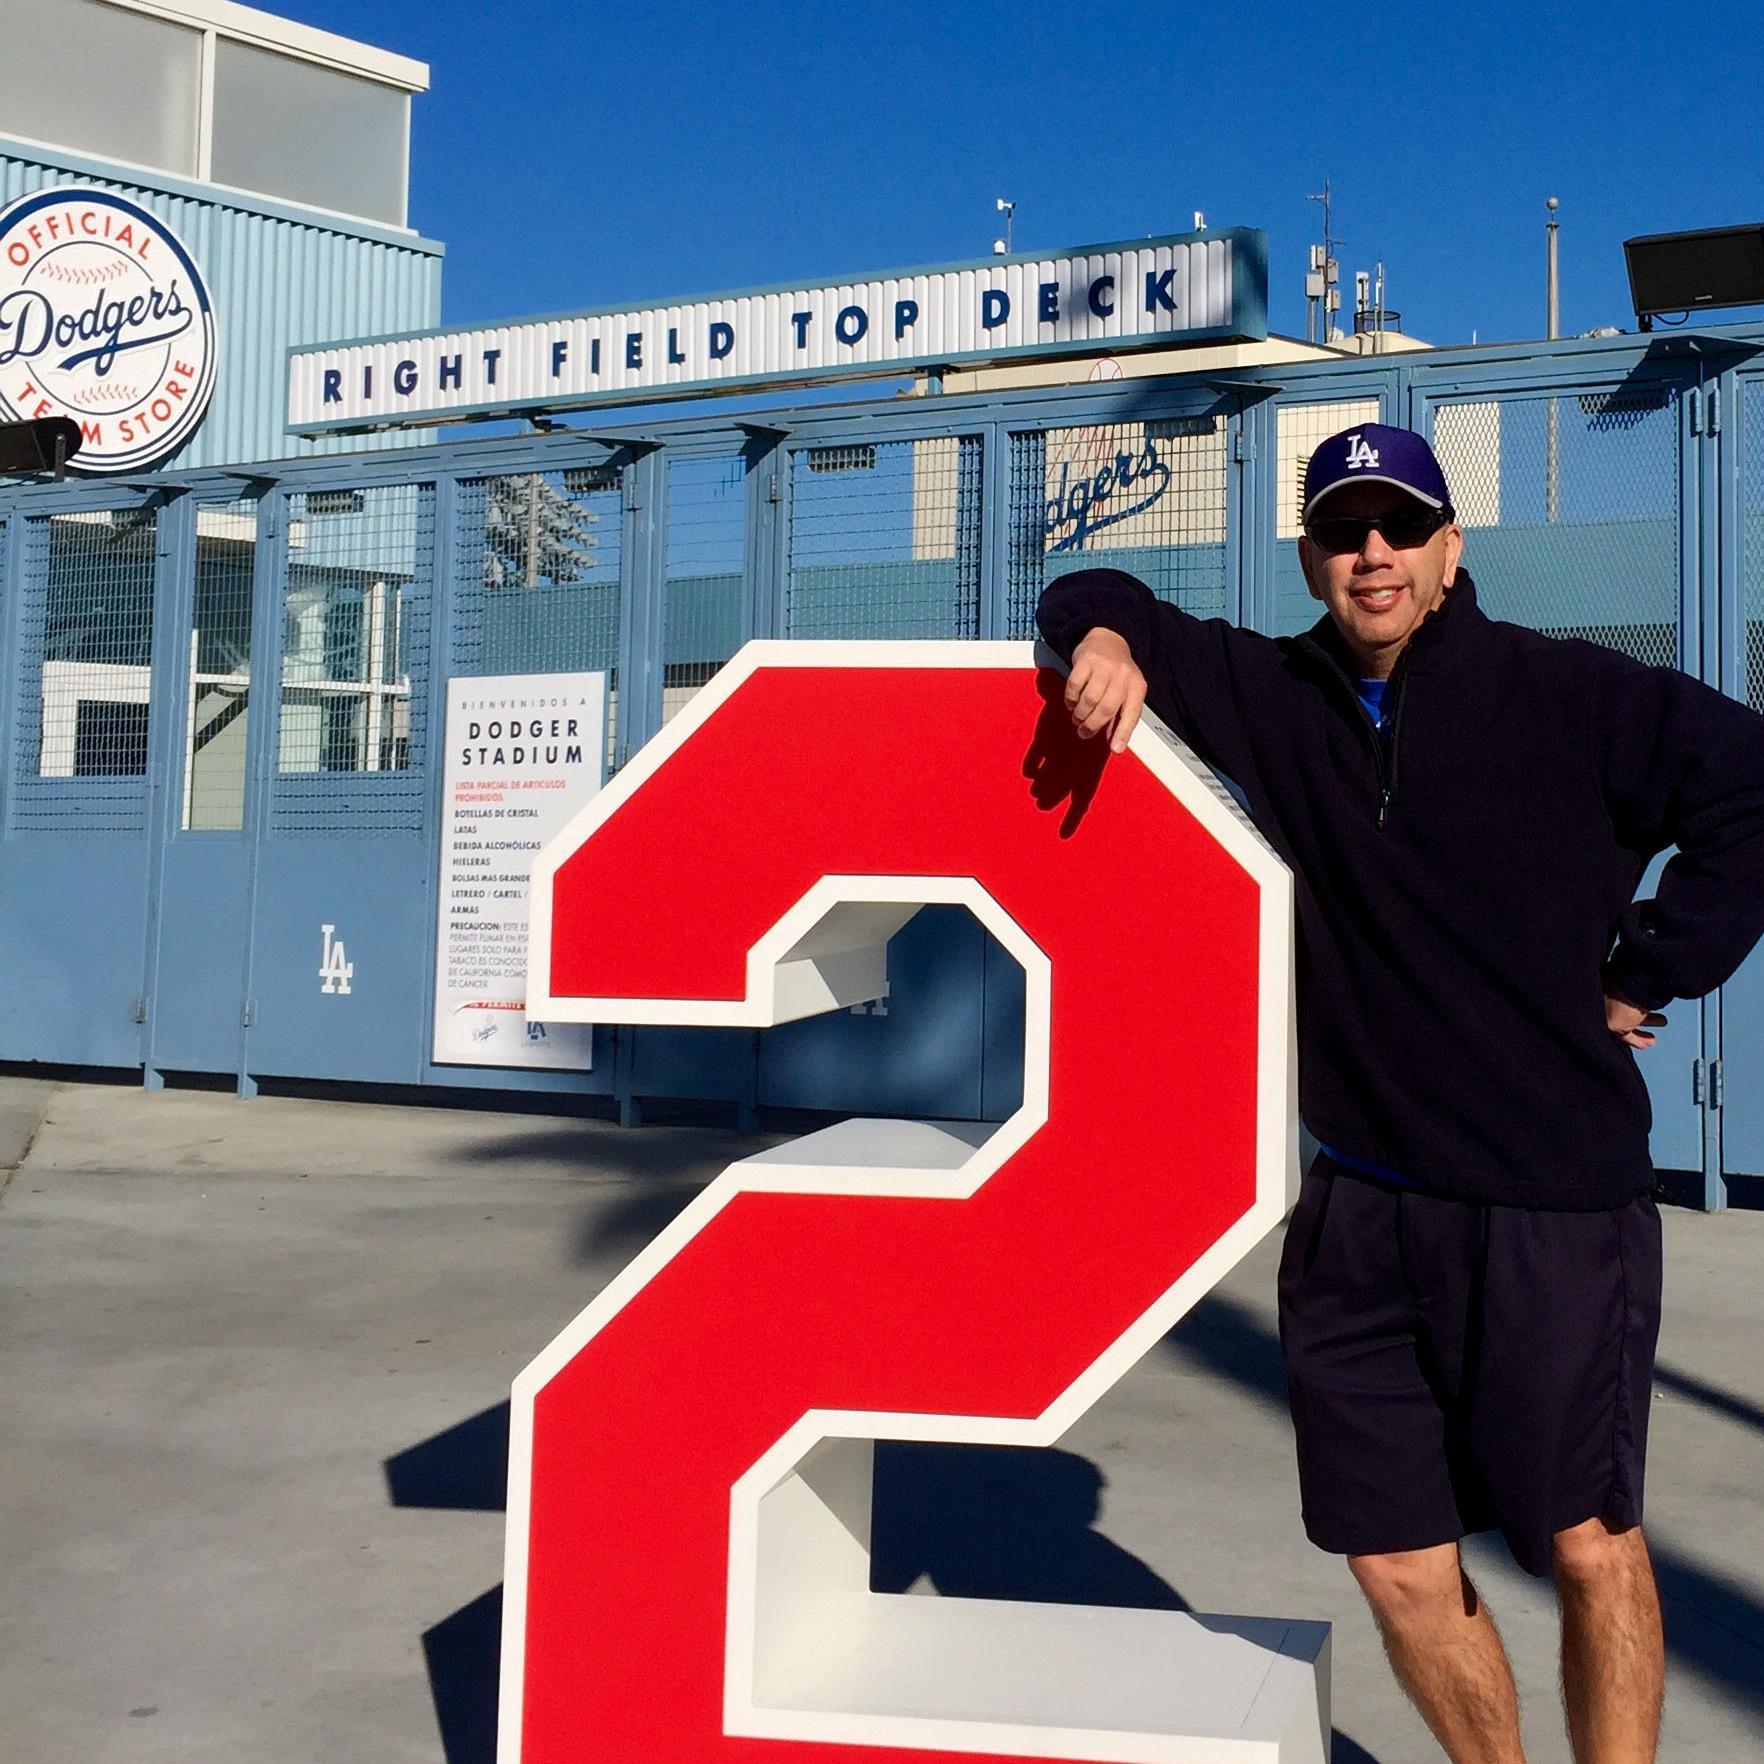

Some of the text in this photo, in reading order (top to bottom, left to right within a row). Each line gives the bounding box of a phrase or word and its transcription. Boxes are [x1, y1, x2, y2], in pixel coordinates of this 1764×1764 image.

[8, 212, 152, 266] OFFICIAL
[0, 279, 193, 377] Dodgers
[323, 269, 1178, 403] RIGHT FIELD TOP DECK
[17, 360, 195, 445] TEM STORE
[1346, 434, 1379, 469] LA
[462, 698, 586, 710] BIENVENIDOS A
[469, 719, 578, 740] DODGER
[462, 745, 582, 765] STADIUM
[456, 781, 474, 790] LISTA
[477, 781, 509, 790] PARCIAL
[511, 780, 520, 789] DE
[455, 793, 503, 802] PROHIBIDOS
[454, 809, 538, 818] BOTELLAS DE CRISTAL
[454, 825, 477, 834] LATAS
[453, 842, 482, 850] BEBIDA
[453, 857, 490, 866] HIELERAS
[452, 874, 479, 882] BOLSAS
[451, 890, 485, 898] LETRERO
[493, 890, 522, 898] CARTEL
[450, 906, 479, 914] ARMAS
[319, 924, 353, 994] LA
